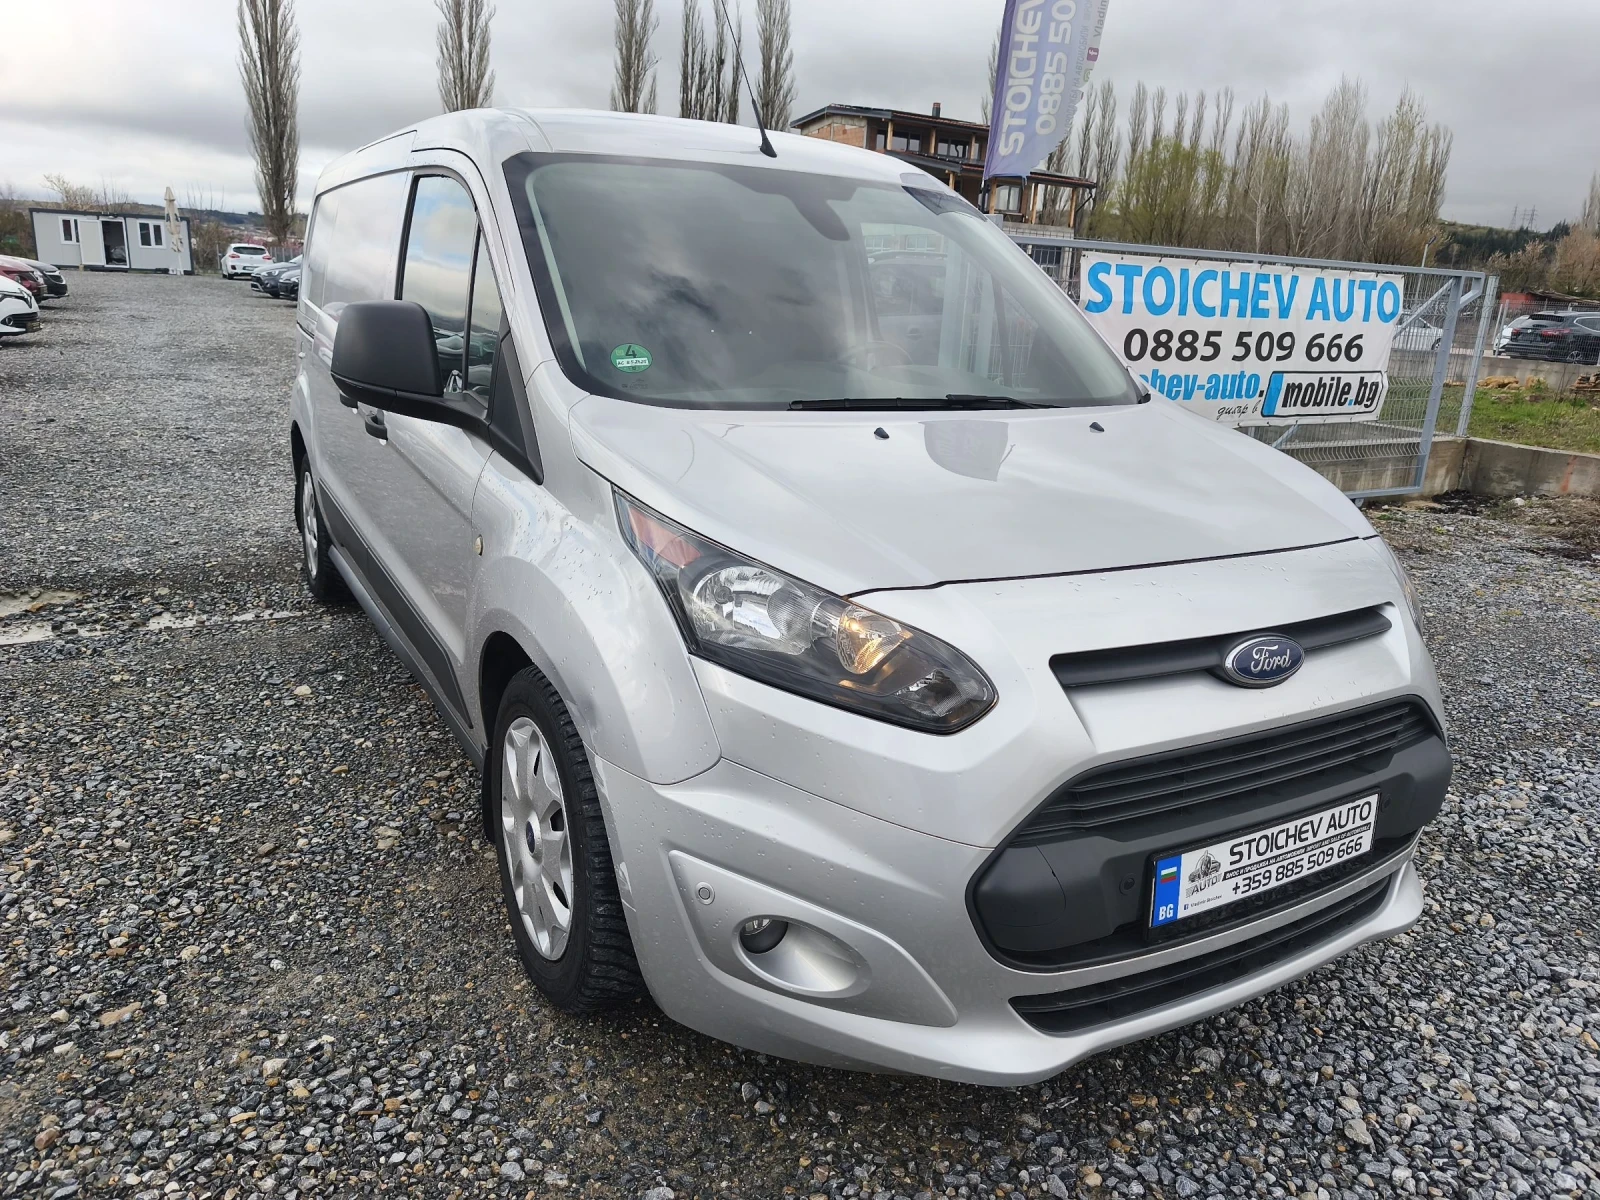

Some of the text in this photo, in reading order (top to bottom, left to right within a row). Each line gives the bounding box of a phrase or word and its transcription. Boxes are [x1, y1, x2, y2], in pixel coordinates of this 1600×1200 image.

[1035, 51, 1068, 135] 0885
[1084, 261, 1400, 323] STOICHEV AUTO
[625, 345, 637, 358] 4
[1123, 328, 1364, 363] 0885 509 666
[1281, 376, 1380, 408] mobile.bg
[1250, 645, 1292, 673] Ford
[1229, 800, 1372, 866] STOICHEV AUTO
[1232, 836, 1363, 895] +359 885 509 666
[1191, 875, 1218, 895] AUTO
[1158, 903, 1174, 921] BG
